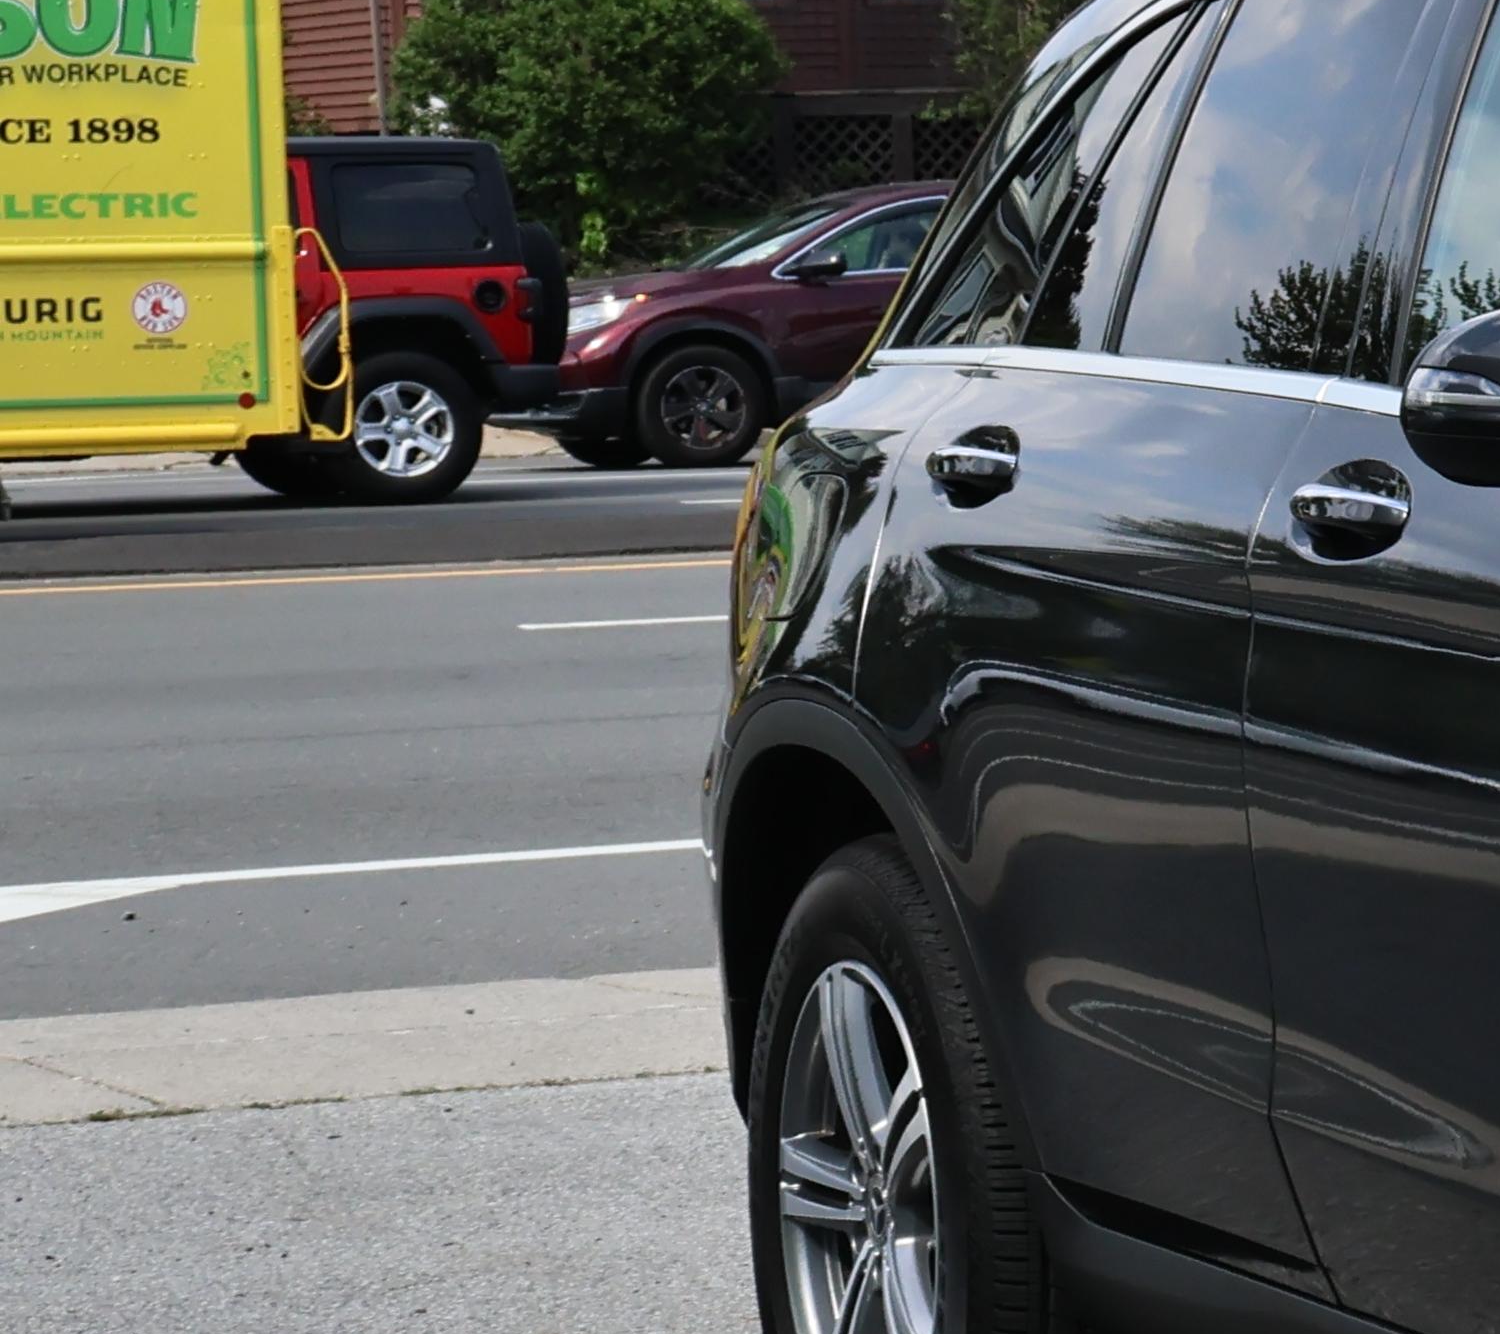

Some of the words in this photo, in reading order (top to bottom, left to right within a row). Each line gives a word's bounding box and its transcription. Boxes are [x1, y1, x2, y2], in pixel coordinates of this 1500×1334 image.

[22, 63, 189, 88] WORKPLACE
[0, 119, 51, 144] CE
[67, 117, 160, 144] 1898
[2, 192, 198, 219] LECTRIC
[4, 296, 104, 324] URIG
[11, 328, 104, 342] MOUNTAIN
